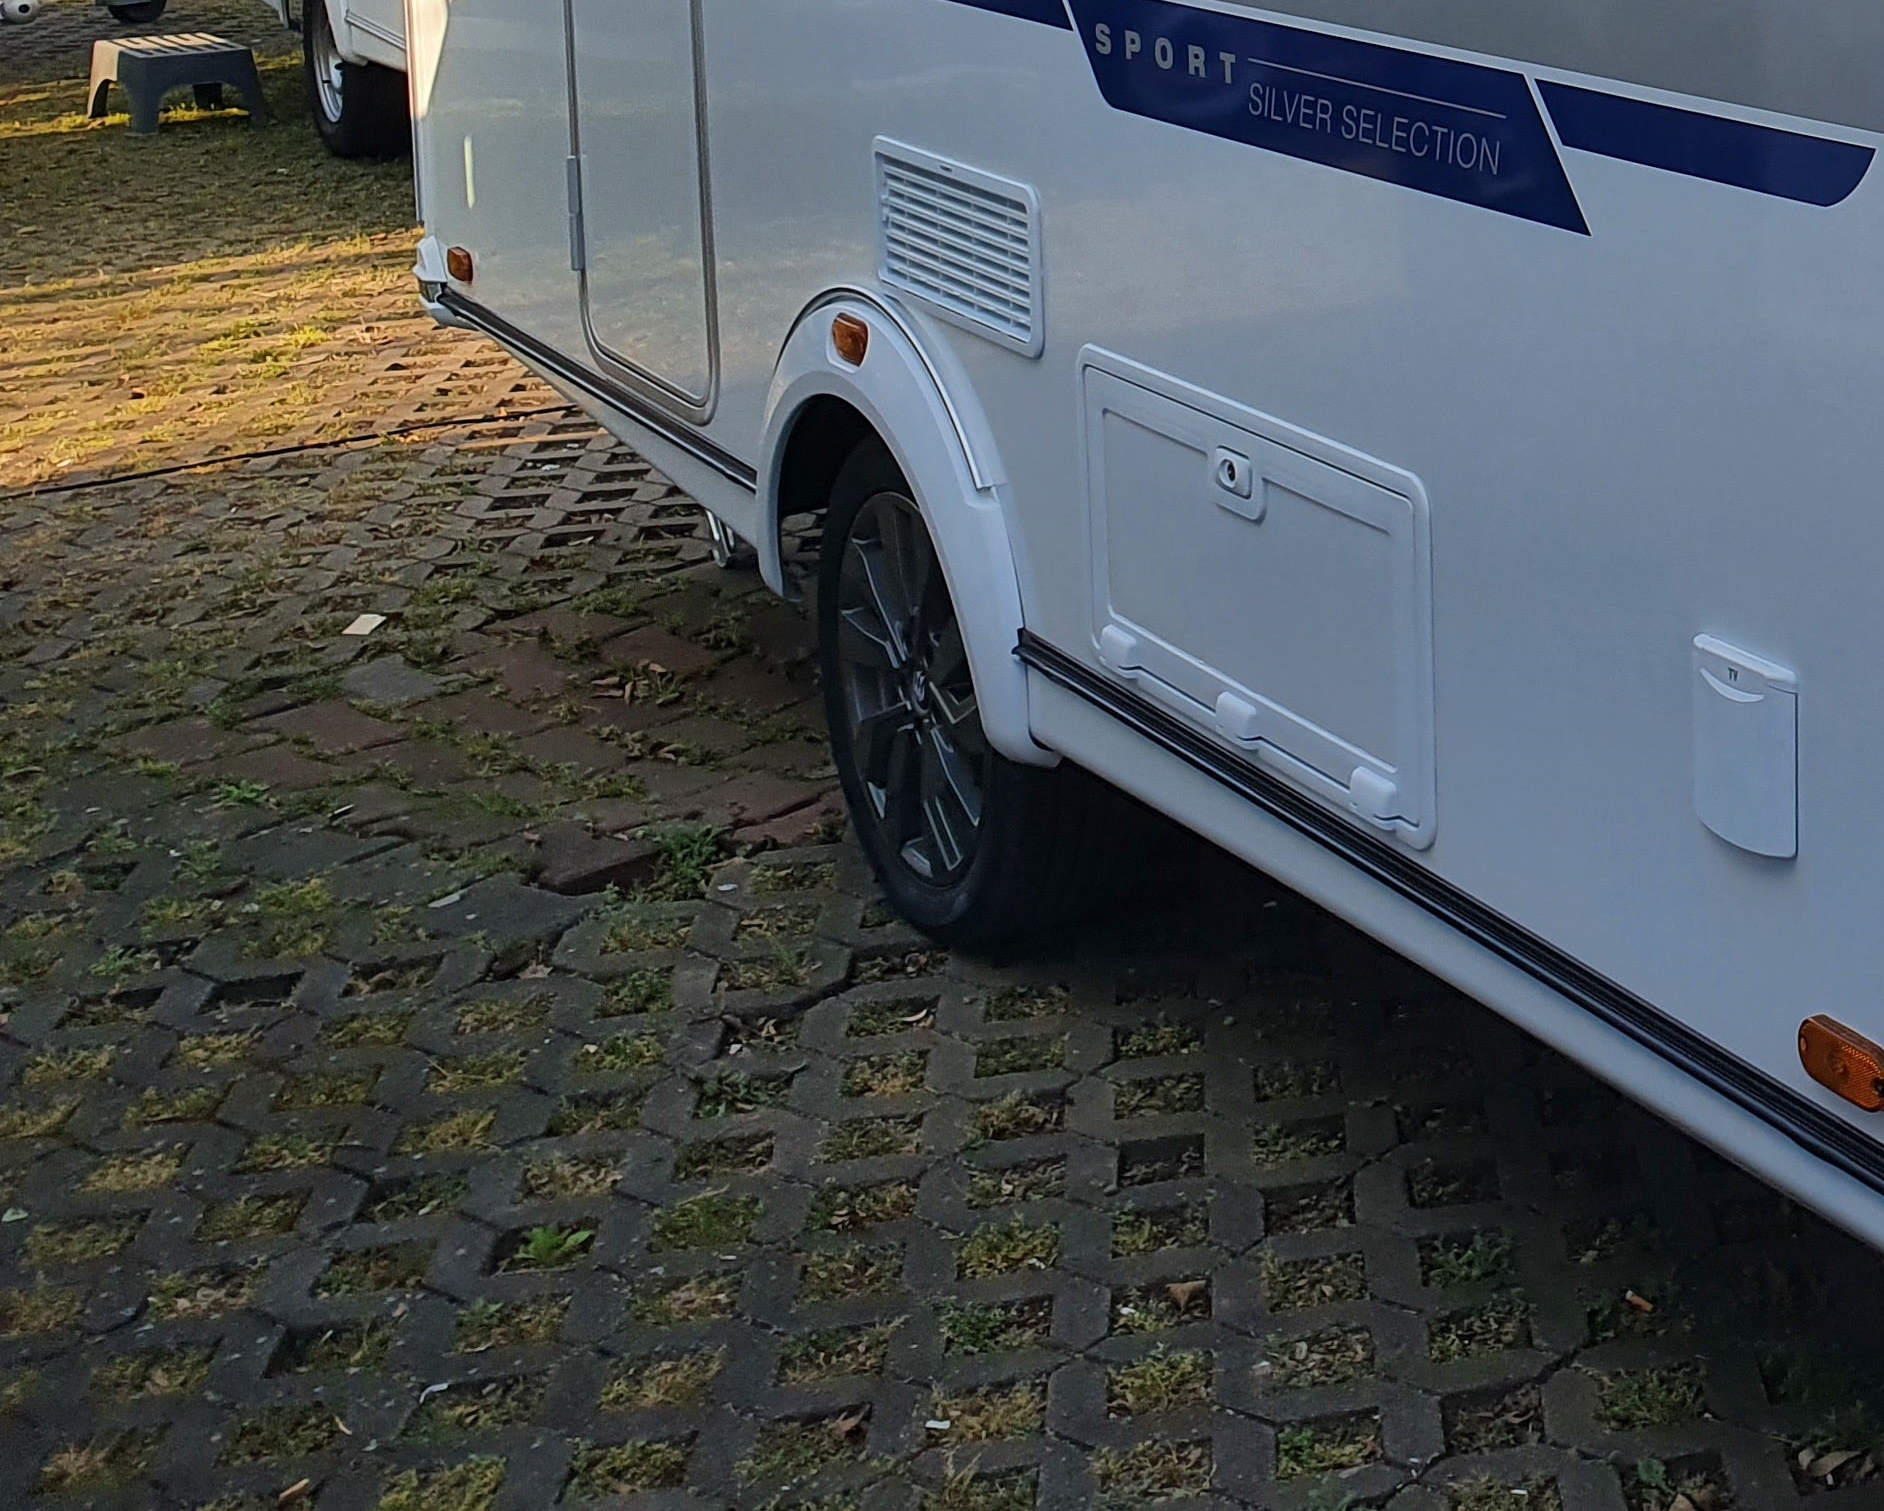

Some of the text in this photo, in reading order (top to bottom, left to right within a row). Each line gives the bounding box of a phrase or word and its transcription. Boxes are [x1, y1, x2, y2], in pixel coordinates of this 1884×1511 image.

[1094, 22, 1237, 85] SPORT
[1248, 81, 1501, 177] SILVER SELECTION
